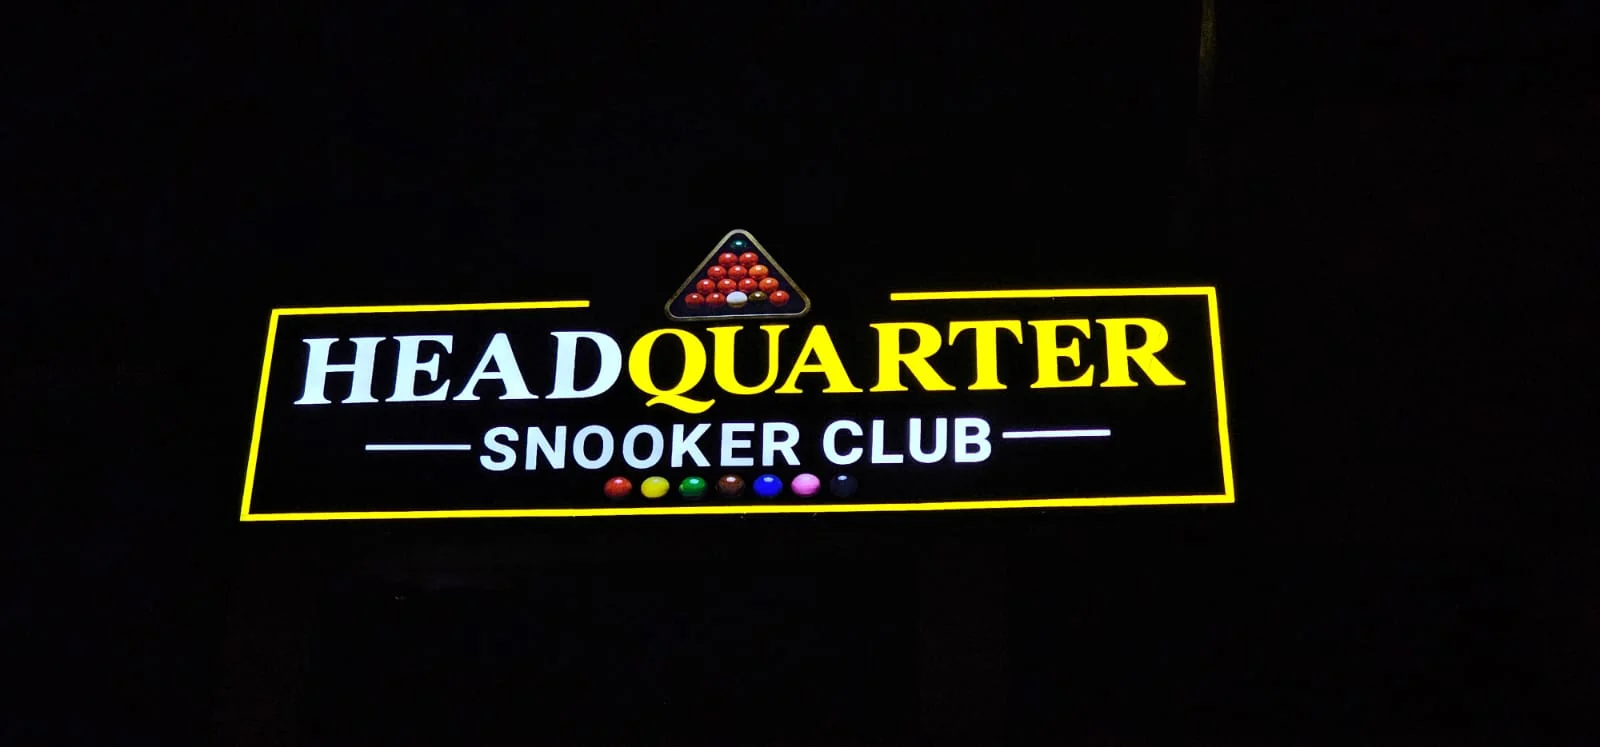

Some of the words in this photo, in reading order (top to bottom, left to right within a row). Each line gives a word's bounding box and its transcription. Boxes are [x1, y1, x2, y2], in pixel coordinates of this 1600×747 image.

[293, 317, 1187, 414] HEADQUARTER
[479, 422, 801, 472] SNOOKER
[822, 416, 992, 466] CLUB
